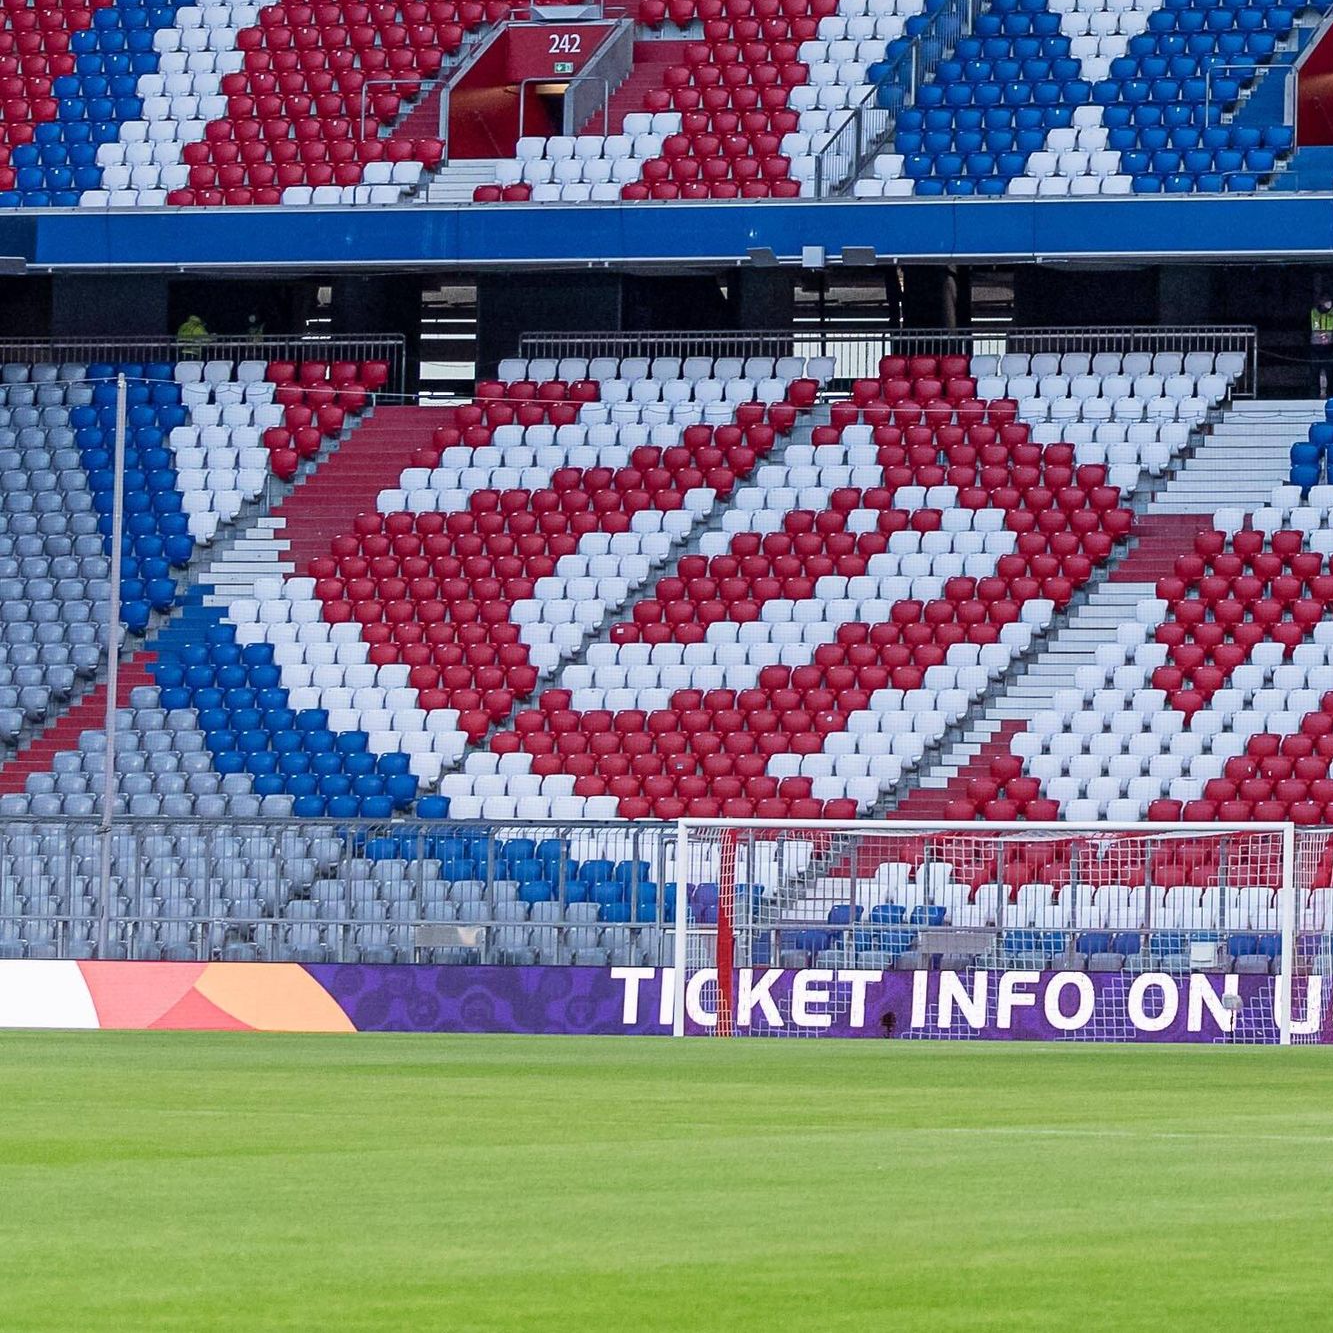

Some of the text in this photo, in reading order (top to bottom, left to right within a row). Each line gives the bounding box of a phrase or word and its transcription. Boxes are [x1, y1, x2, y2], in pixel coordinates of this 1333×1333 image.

[549, 34, 581, 53] 242
[610, 967, 880, 1029] TICKET
[911, 970, 1095, 1032] INFO
[1127, 972, 1239, 1033] ON
